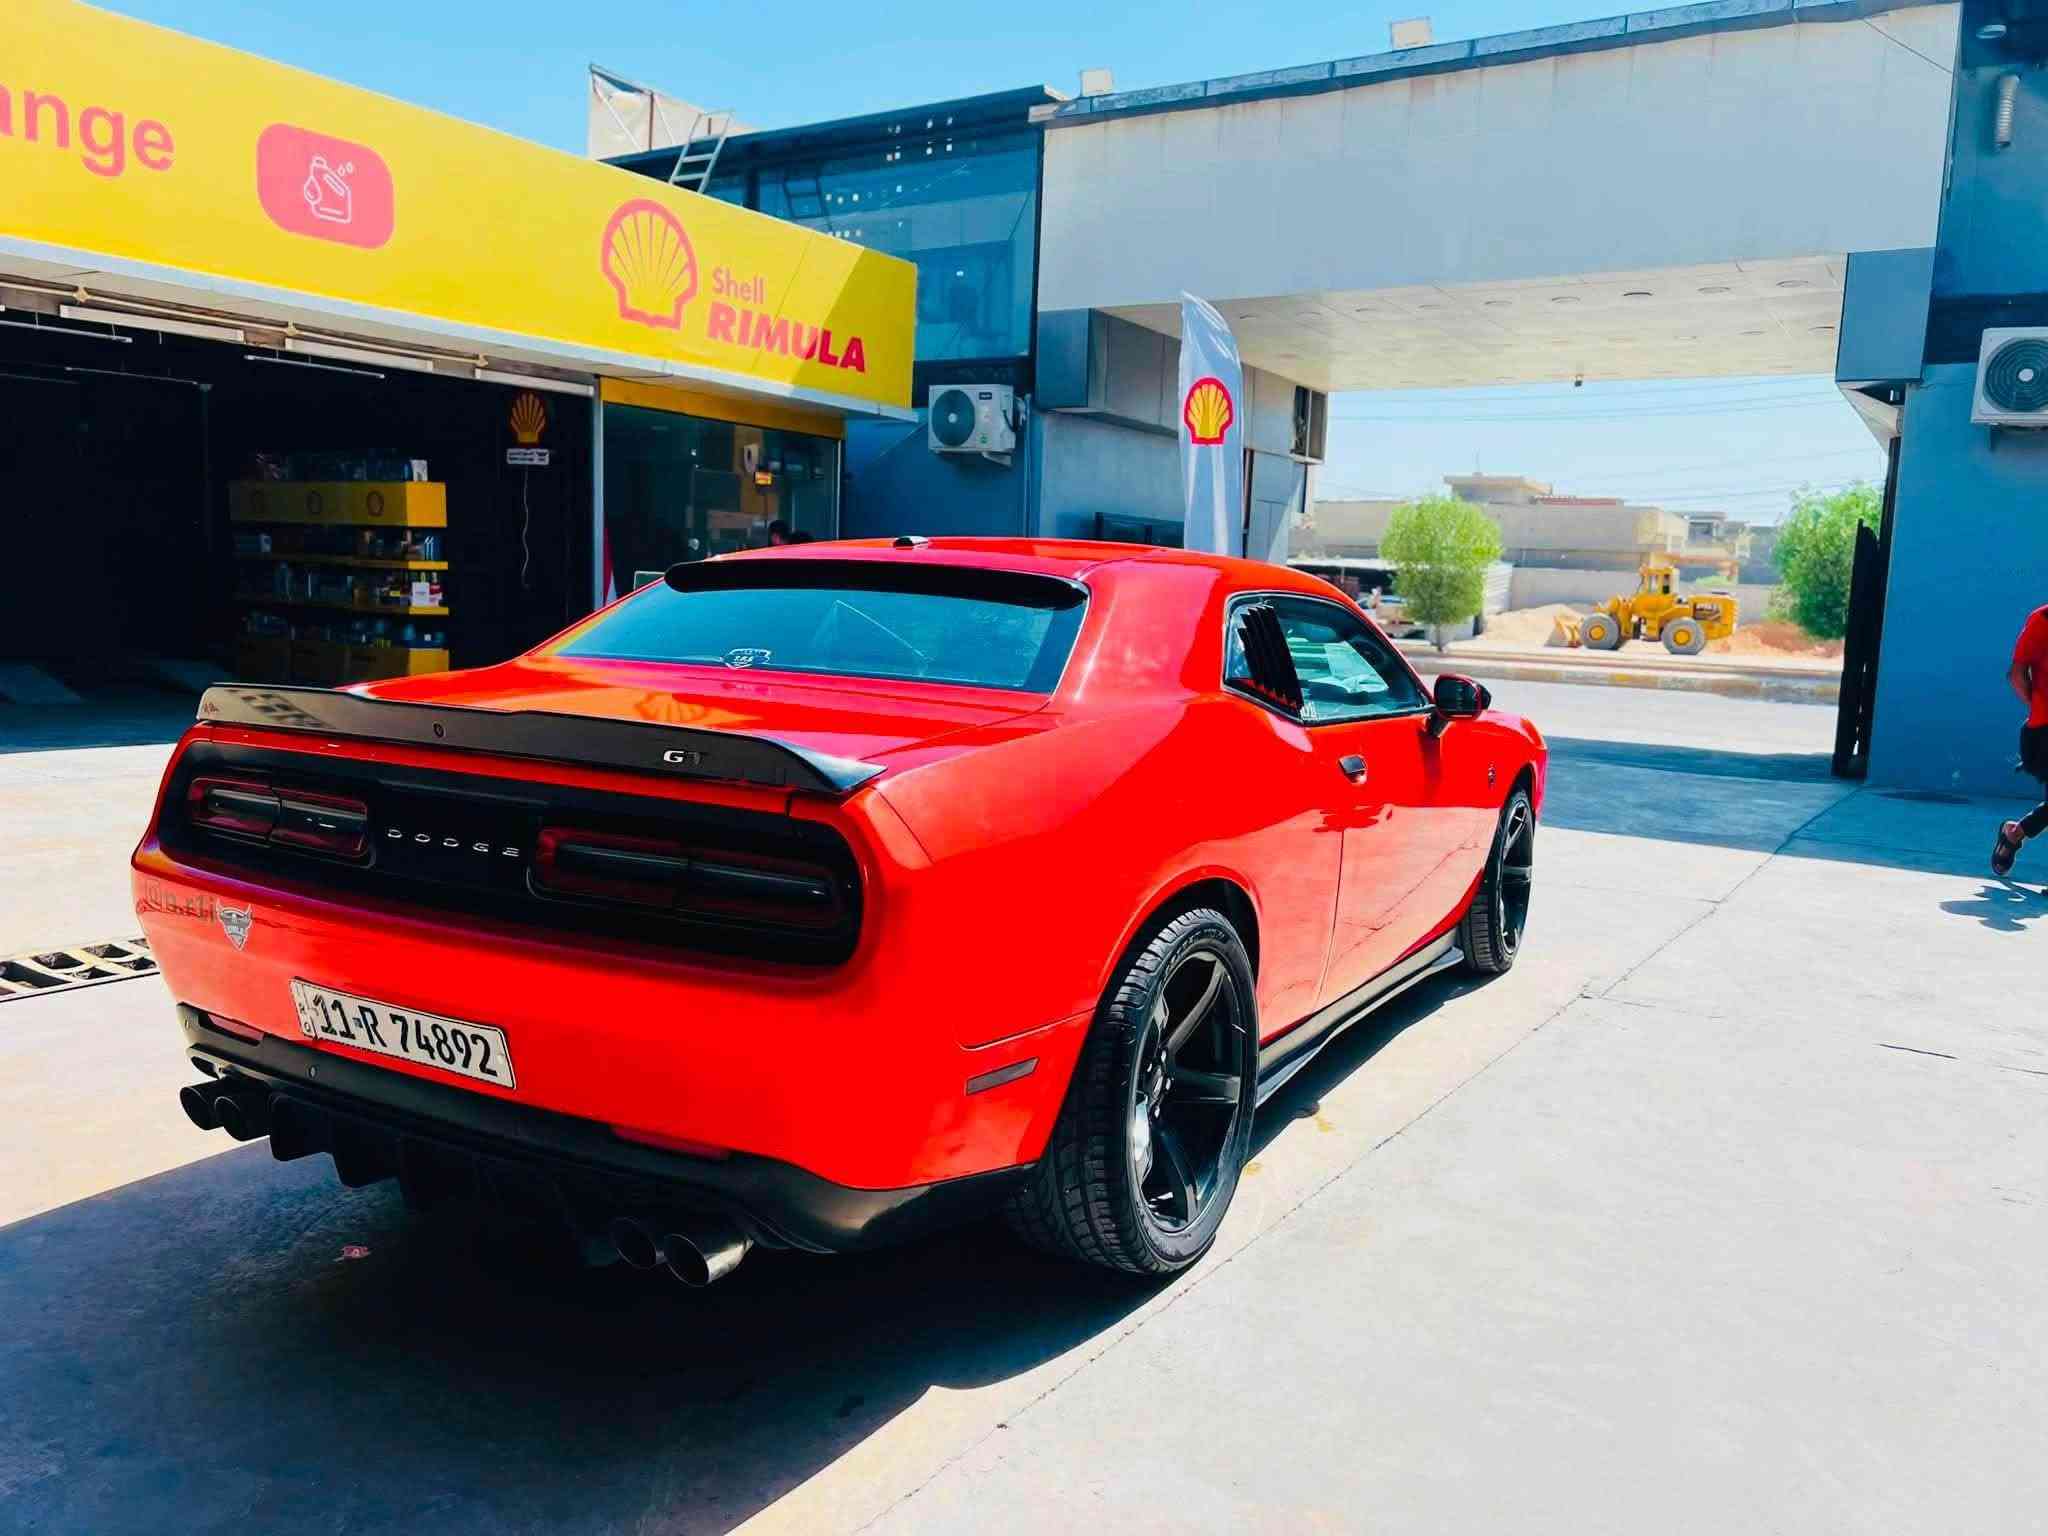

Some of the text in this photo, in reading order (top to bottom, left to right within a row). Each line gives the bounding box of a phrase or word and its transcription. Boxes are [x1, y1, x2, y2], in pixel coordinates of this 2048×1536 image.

[712, 266, 764, 304] Shell
[707, 301, 866, 373] RIMULA
[386, 828, 520, 857] DODGE
[389, 1013, 498, 1076] 74892
